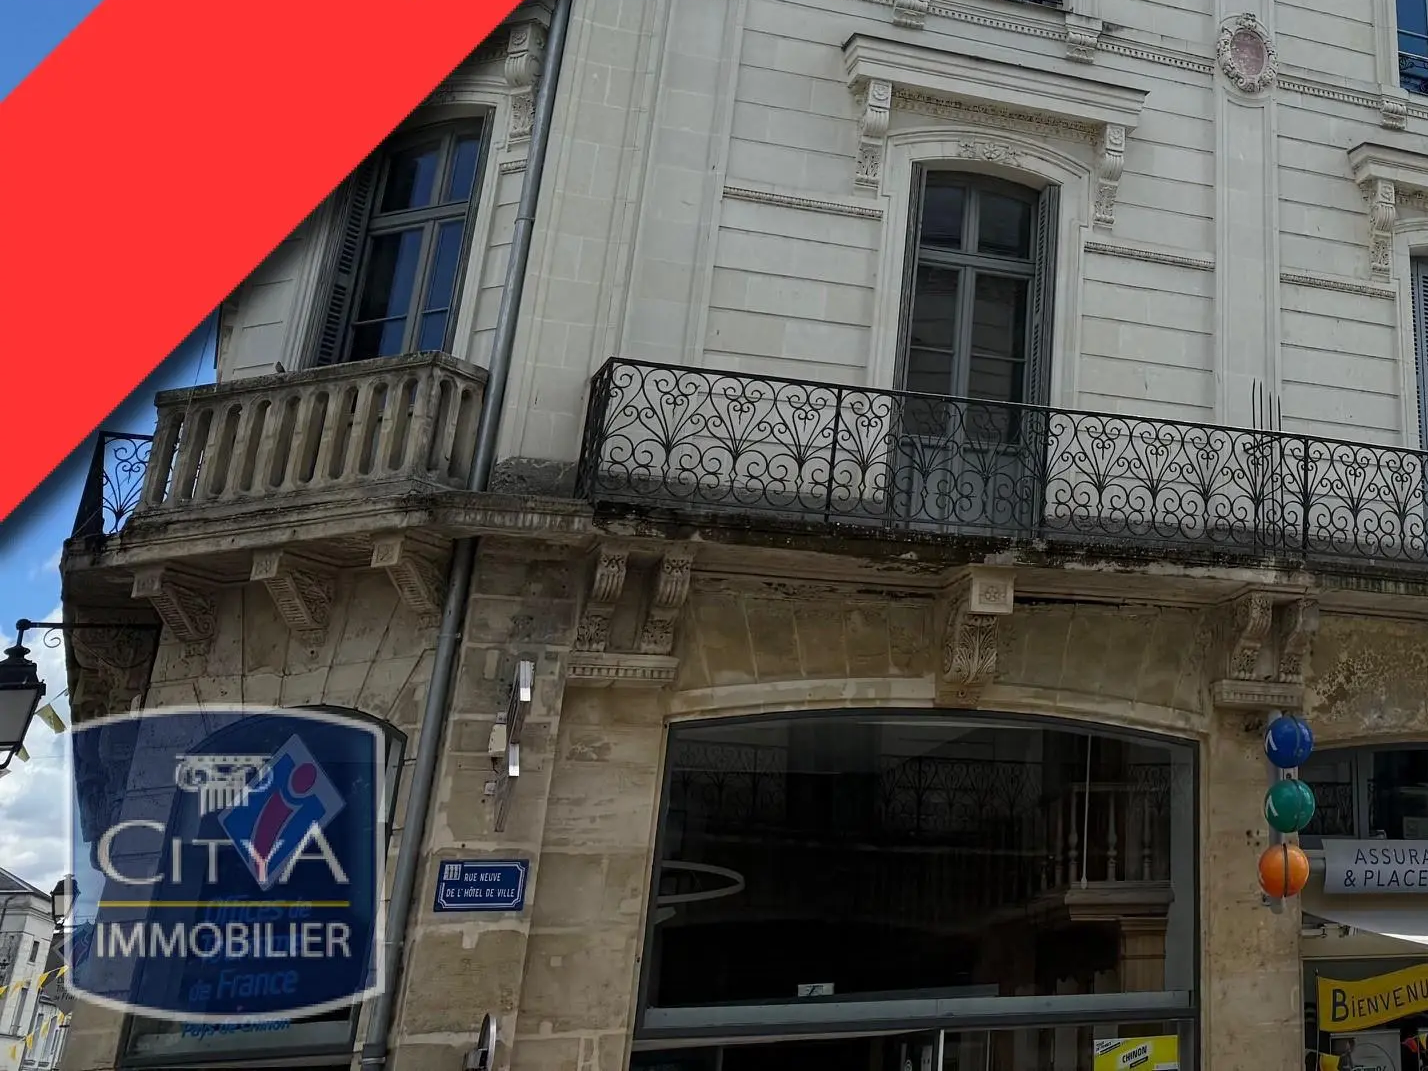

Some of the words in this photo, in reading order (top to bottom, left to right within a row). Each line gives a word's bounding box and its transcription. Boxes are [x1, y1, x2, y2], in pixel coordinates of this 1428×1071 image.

[463, 873, 478, 882] RUE
[479, 873, 502, 882] NEUVE
[1343, 870, 1356, 887] &
[445, 888, 455, 898] DE
[485, 888, 495, 898] DE
[497, 888, 516, 898] VILLE
[216, 968, 299, 1000] France
[1122, 1044, 1148, 1063] CHINON
